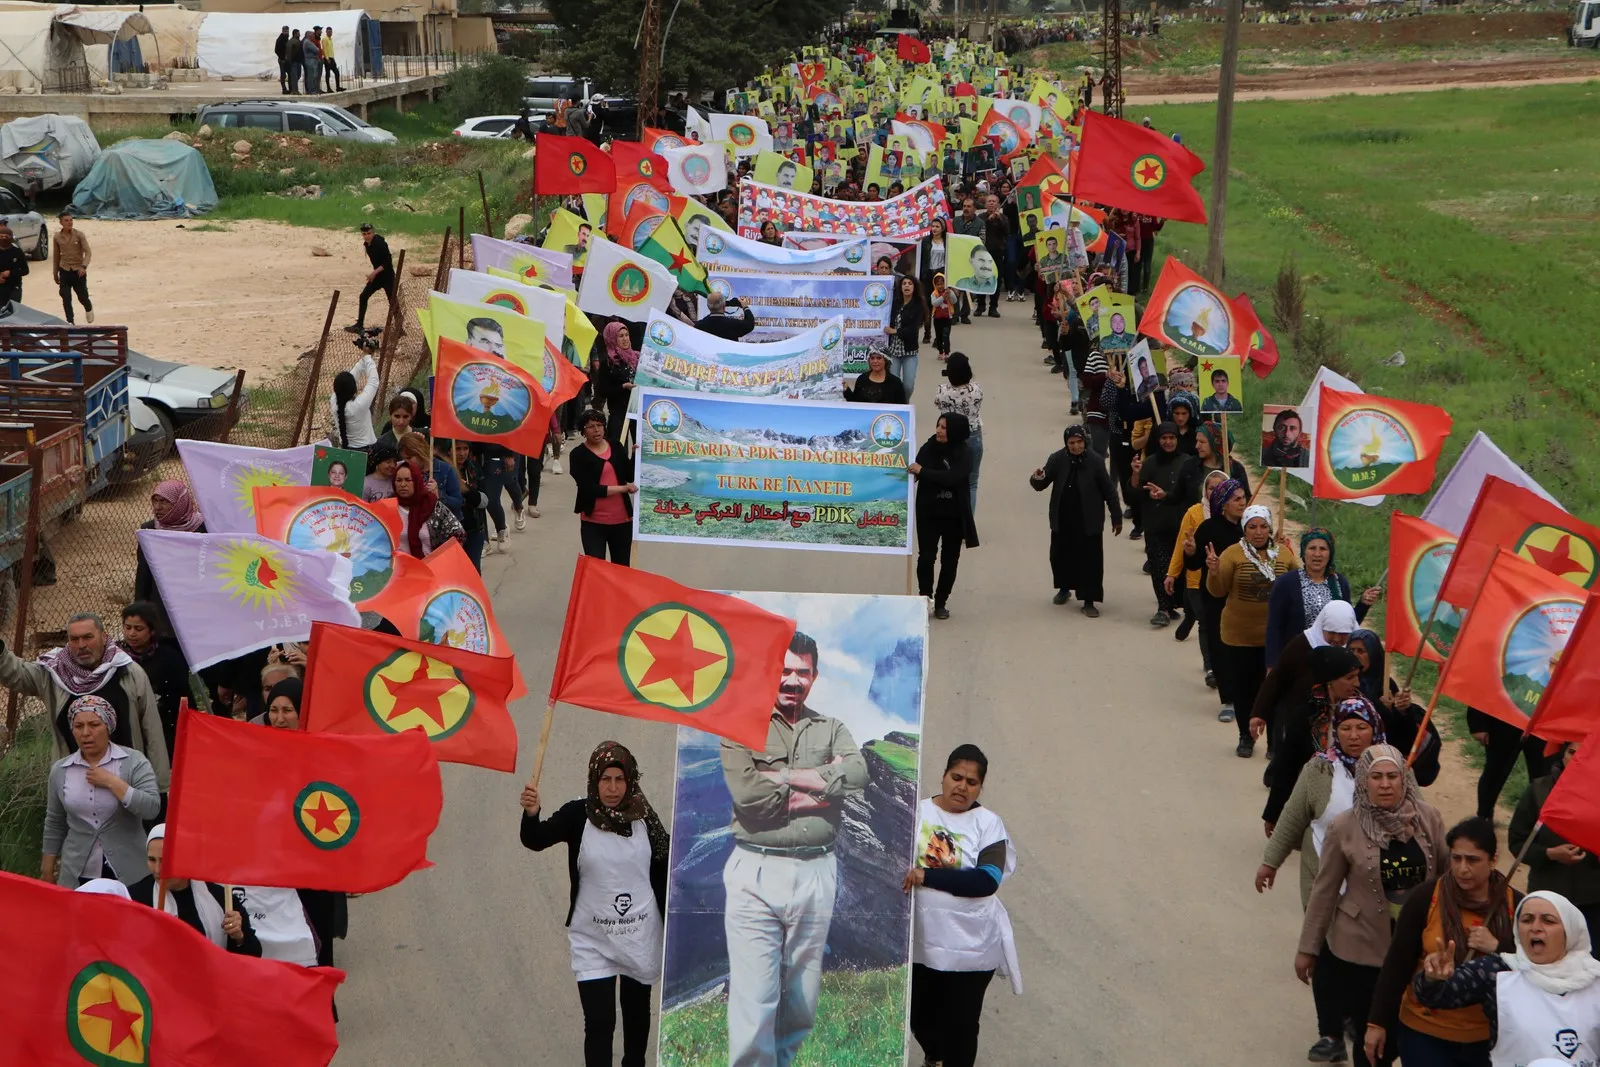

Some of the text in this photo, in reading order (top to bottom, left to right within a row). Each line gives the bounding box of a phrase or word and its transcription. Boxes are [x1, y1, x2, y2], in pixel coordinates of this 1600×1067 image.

[842, 298, 860, 308] PDK
[663, 353, 829, 387] BIMRÊ ÎXANETA PDK
[471, 416, 498, 429] M.M.Ş
[653, 439, 907, 468] HEVKARIYA PDK BI DAGIRKERIYA
[716, 474, 852, 496] TURK RE ÎXANETE
[1352, 469, 1377, 482] M.M.Ş
[653, 499, 692, 519] خيانة
[695, 501, 742, 525] التركي
[814, 505, 855, 524] PDK
[791, 510, 811, 528] مع
[857, 510, 899, 529] تعامل
